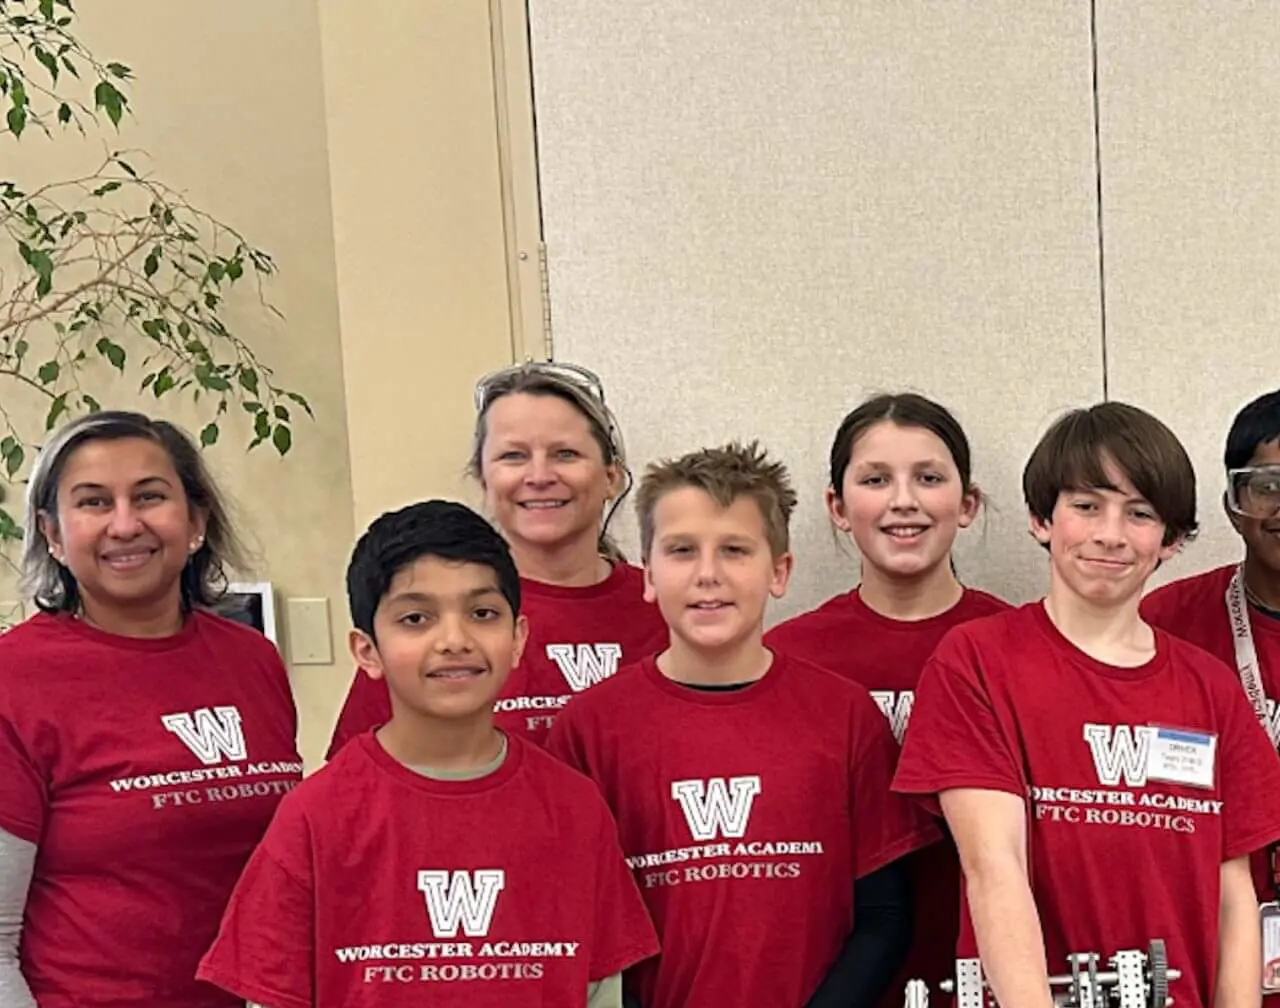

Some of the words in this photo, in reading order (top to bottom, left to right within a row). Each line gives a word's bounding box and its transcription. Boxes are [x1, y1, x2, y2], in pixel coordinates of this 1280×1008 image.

[545, 643, 622, 692] W
[493, 694, 572, 713] ORCES
[161, 706, 247, 765] W
[526, 715, 556, 731] FT
[1084, 723, 1152, 787] W
[110, 764, 242, 793] WORCESTER
[246, 761, 304, 775] ACADEM
[151, 790, 202, 809] FTC
[206, 780, 297, 802] ROBOTI
[671, 775, 761, 841] W
[1028, 786, 1135, 805] ORCESTER
[1138, 793, 1225, 815] ACADEMY
[1036, 804, 1080, 822] FTC
[1084, 809, 1196, 834] ROBOTICS
[685, 862, 801, 883] ROBOTICS
[417, 869, 505, 938] W
[335, 942, 474, 963] WORCESTER
[478, 941, 579, 957] ACADEMY
[364, 966, 414, 982] FTC
[420, 963, 544, 981] ROBOTICS
